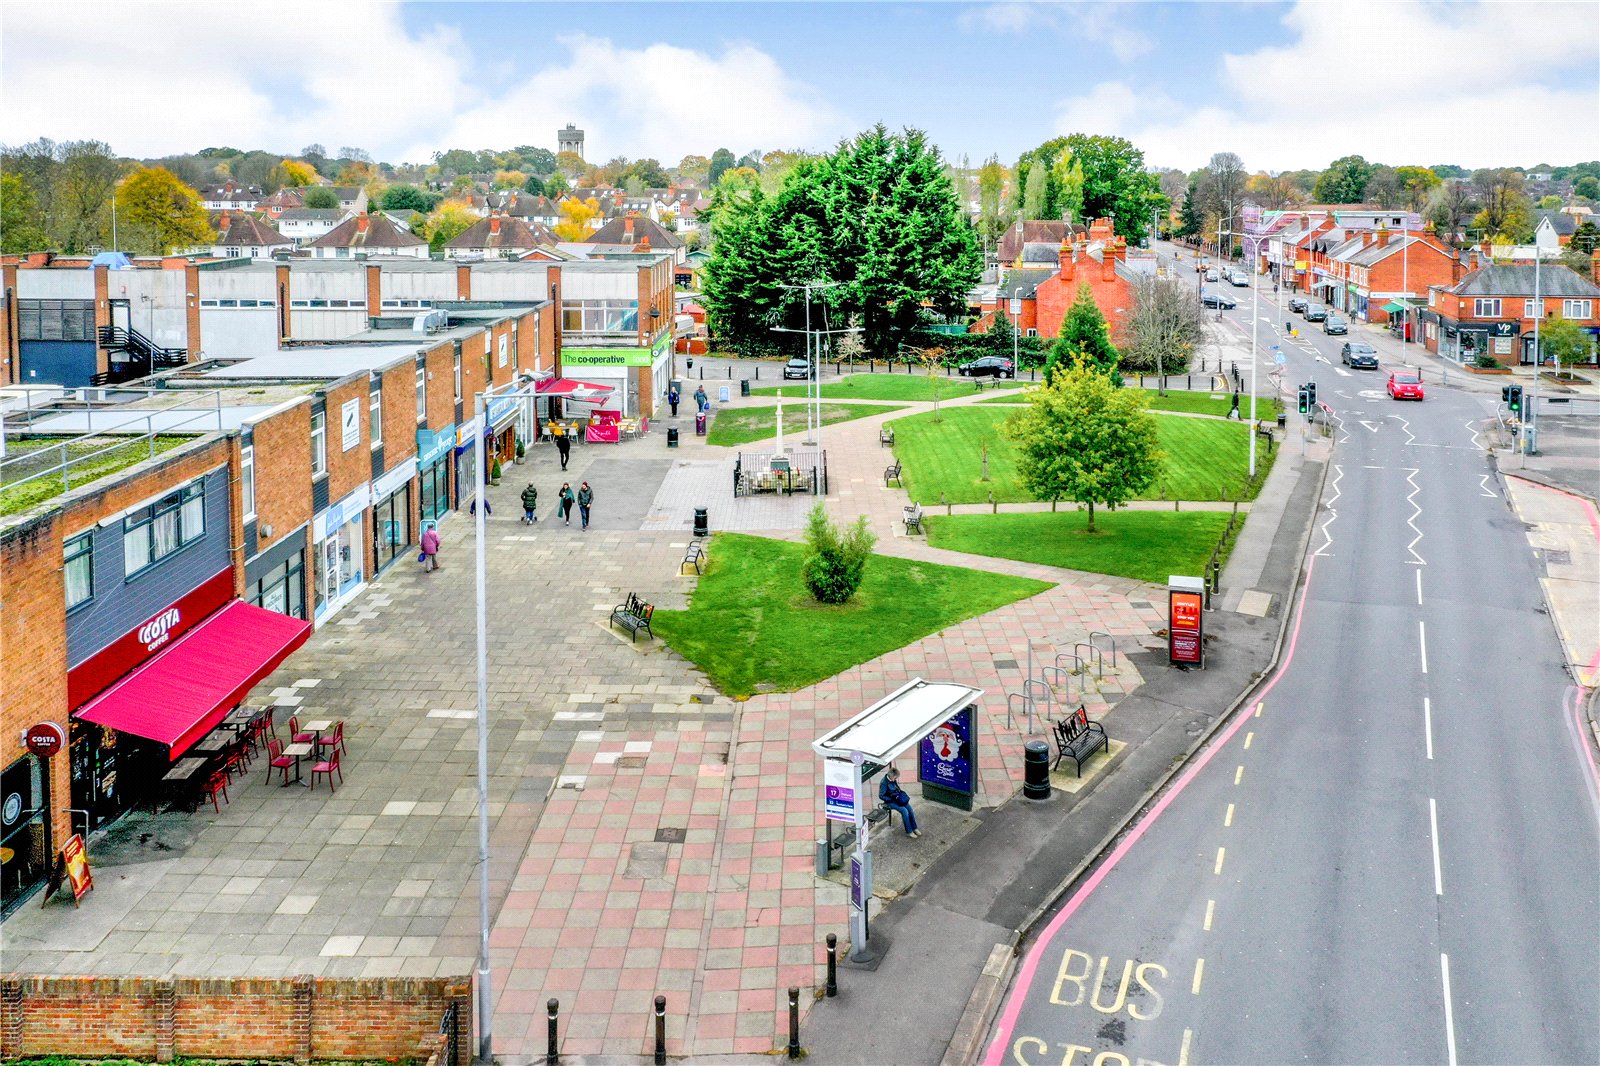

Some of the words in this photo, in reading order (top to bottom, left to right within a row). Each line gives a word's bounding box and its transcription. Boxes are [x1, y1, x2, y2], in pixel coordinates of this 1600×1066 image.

[564, 354, 577, 363] The
[577, 355, 625, 364] co-operative
[138, 608, 180, 643] COSTA
[147, 632, 169, 652] COFFEE
[1049, 948, 1168, 1021] BUS
